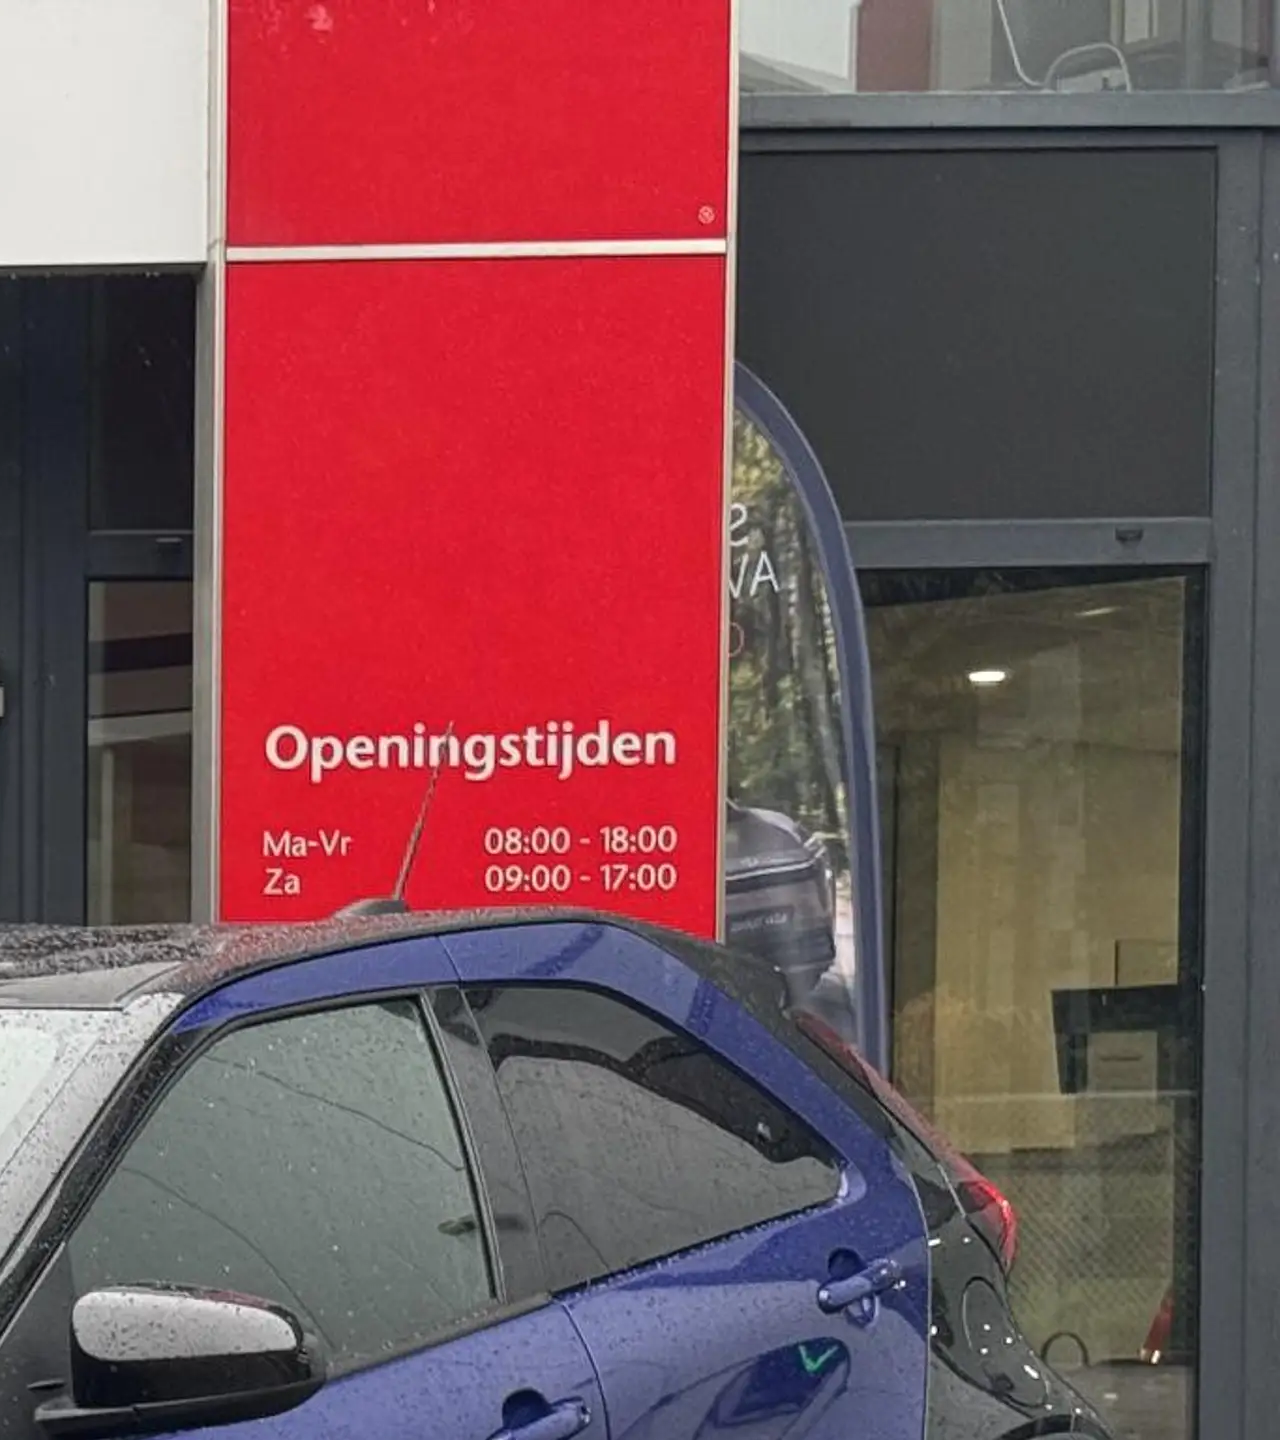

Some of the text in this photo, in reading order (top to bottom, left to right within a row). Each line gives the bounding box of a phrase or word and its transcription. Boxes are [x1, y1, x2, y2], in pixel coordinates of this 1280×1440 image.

[265, 719, 677, 783] Openingstijden
[262, 829, 353, 857] Ma-Vr
[484, 827, 571, 854] 08:00
[600, 826, 677, 853] 18:00
[262, 868, 301, 894] Za
[485, 865, 571, 892] 09:00
[600, 864, 677, 891] 17:00
